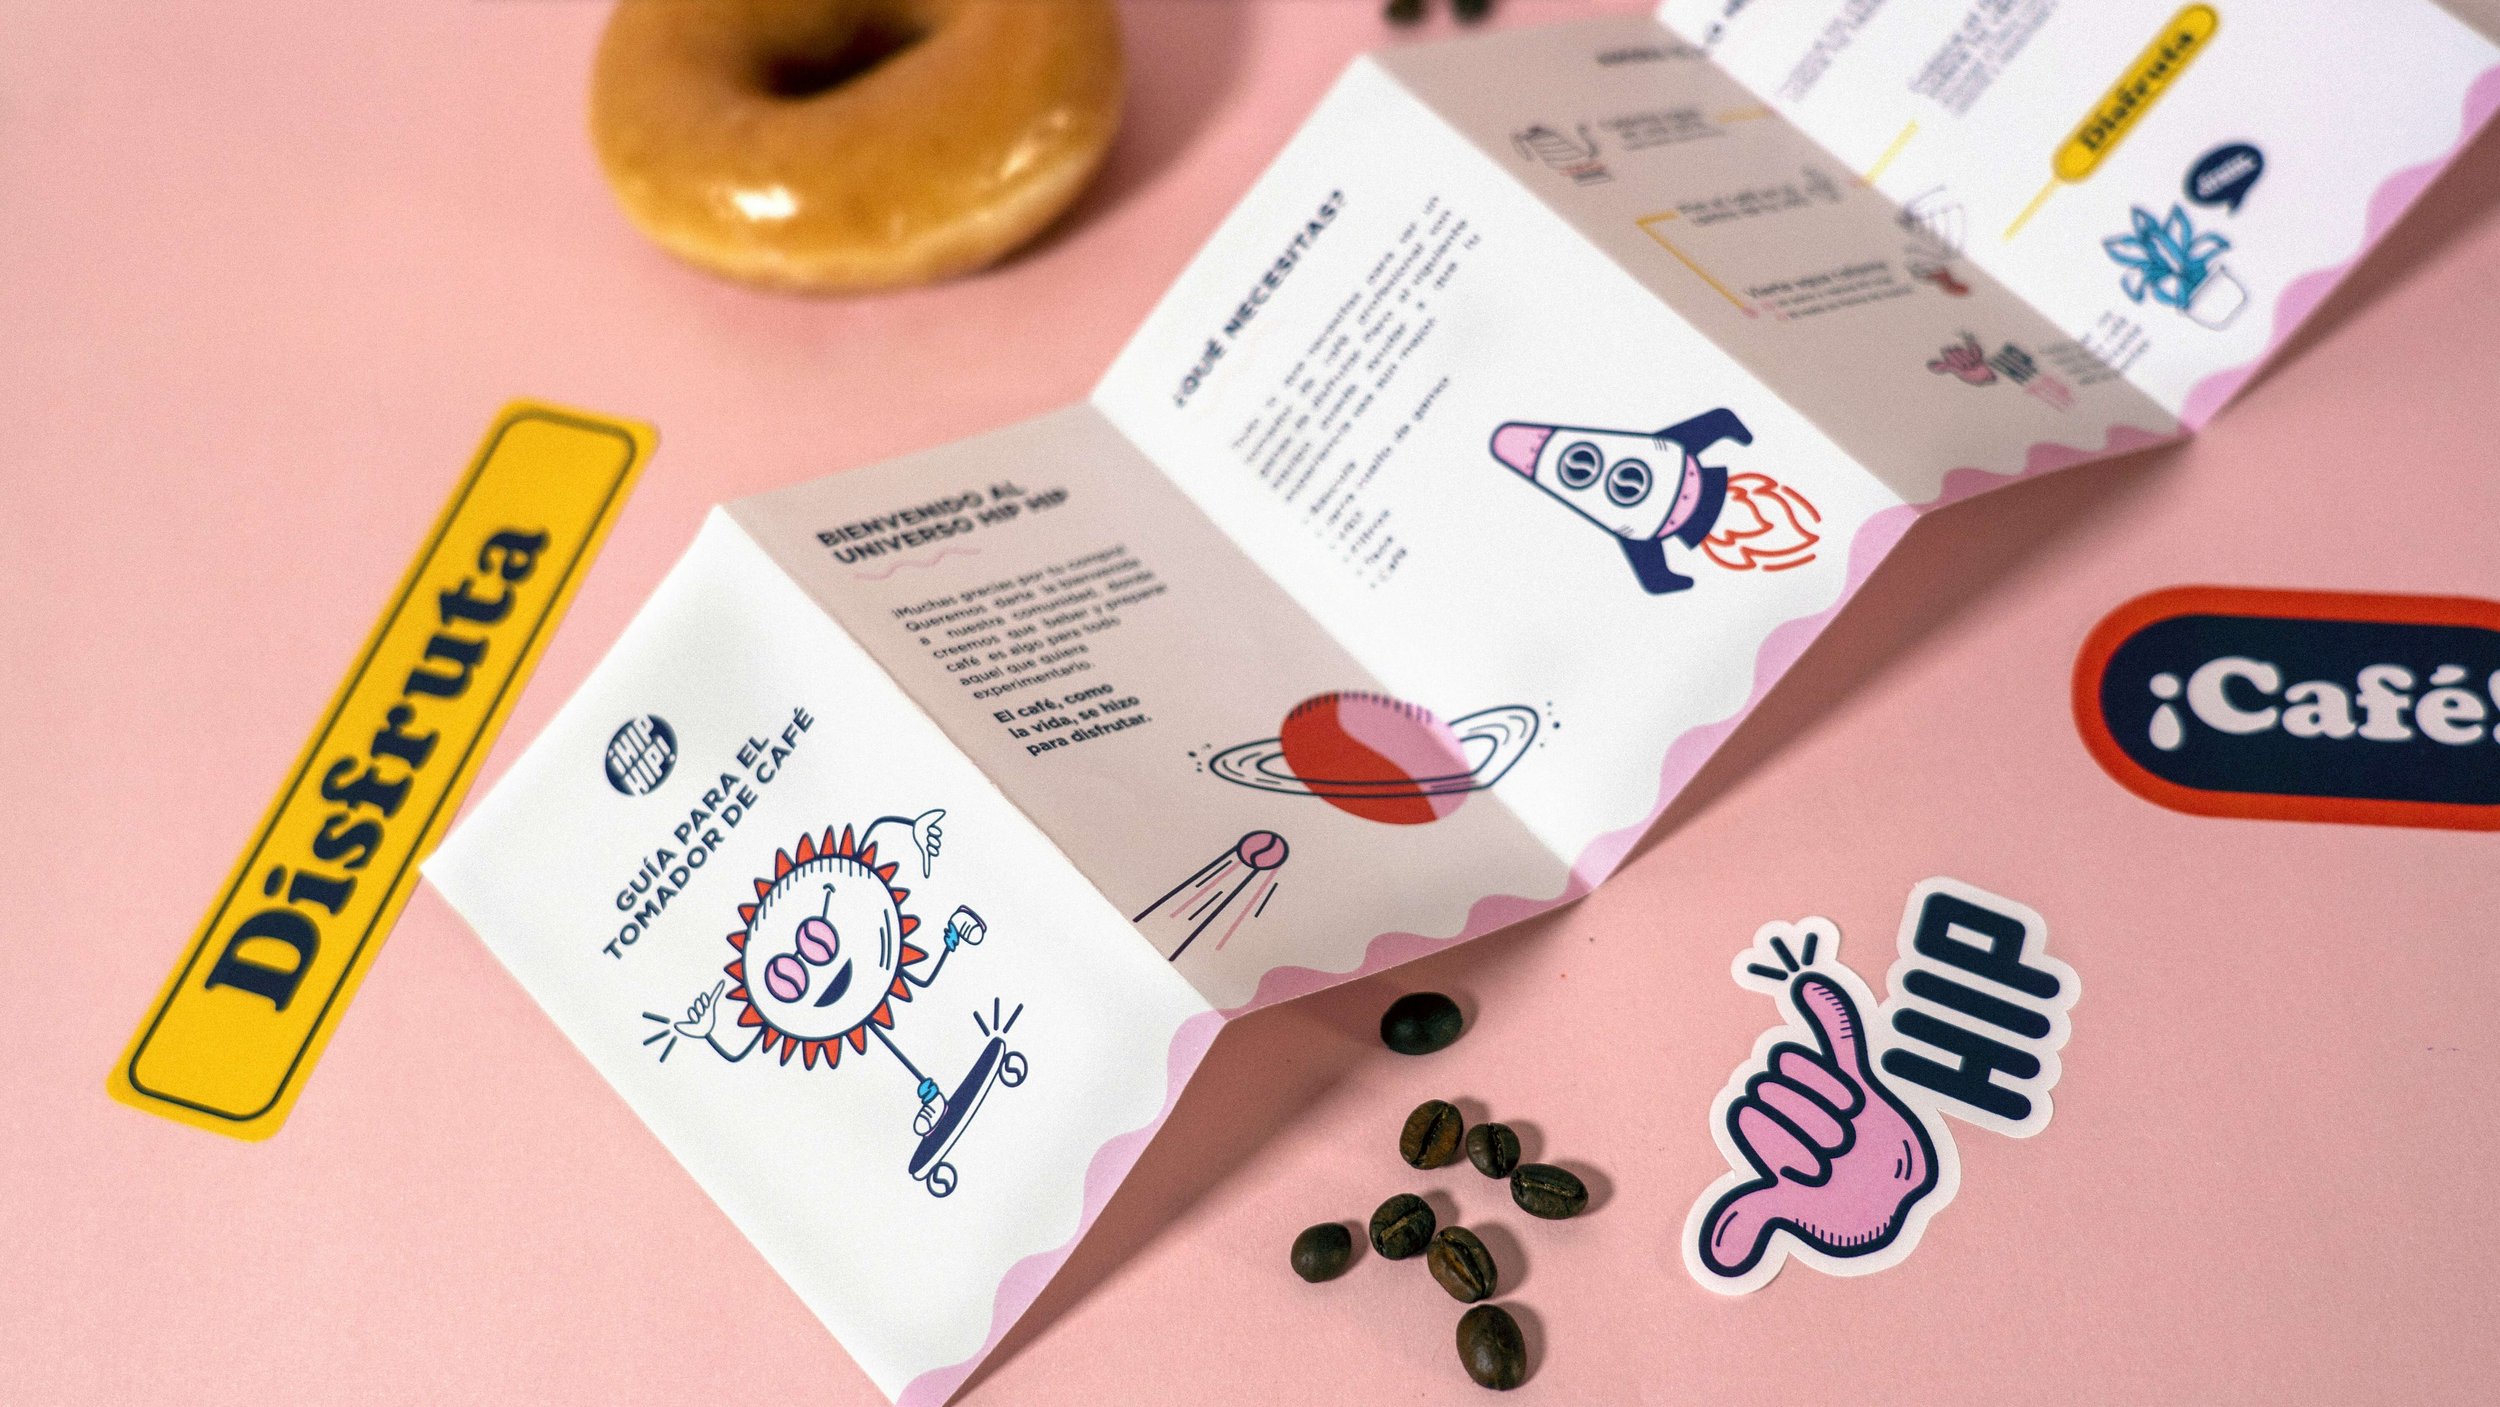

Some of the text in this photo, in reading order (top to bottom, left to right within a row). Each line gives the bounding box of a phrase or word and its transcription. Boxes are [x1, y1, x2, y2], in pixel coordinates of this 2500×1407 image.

[1223, 188, 1346, 339] NECESITAS?
[817, 480, 1026, 547] BIENVENIDO AL
[834, 488, 1068, 564] UNIVERSO HIP HIP
[946, 656, 981, 672] café
[959, 667, 1004, 686] aquel
[993, 684, 1114, 724] El café, como
[1008, 696, 1140, 739] la vida, se hizo
[1026, 713, 1153, 757] para disfrutar.
[204, 526, 551, 1013] Disfruta
[603, 706, 815, 960] TOMADOR DE CAFÉ
[616, 737, 769, 911] GUÍA PARA EL
[1881, 892, 2060, 1120] HIP
